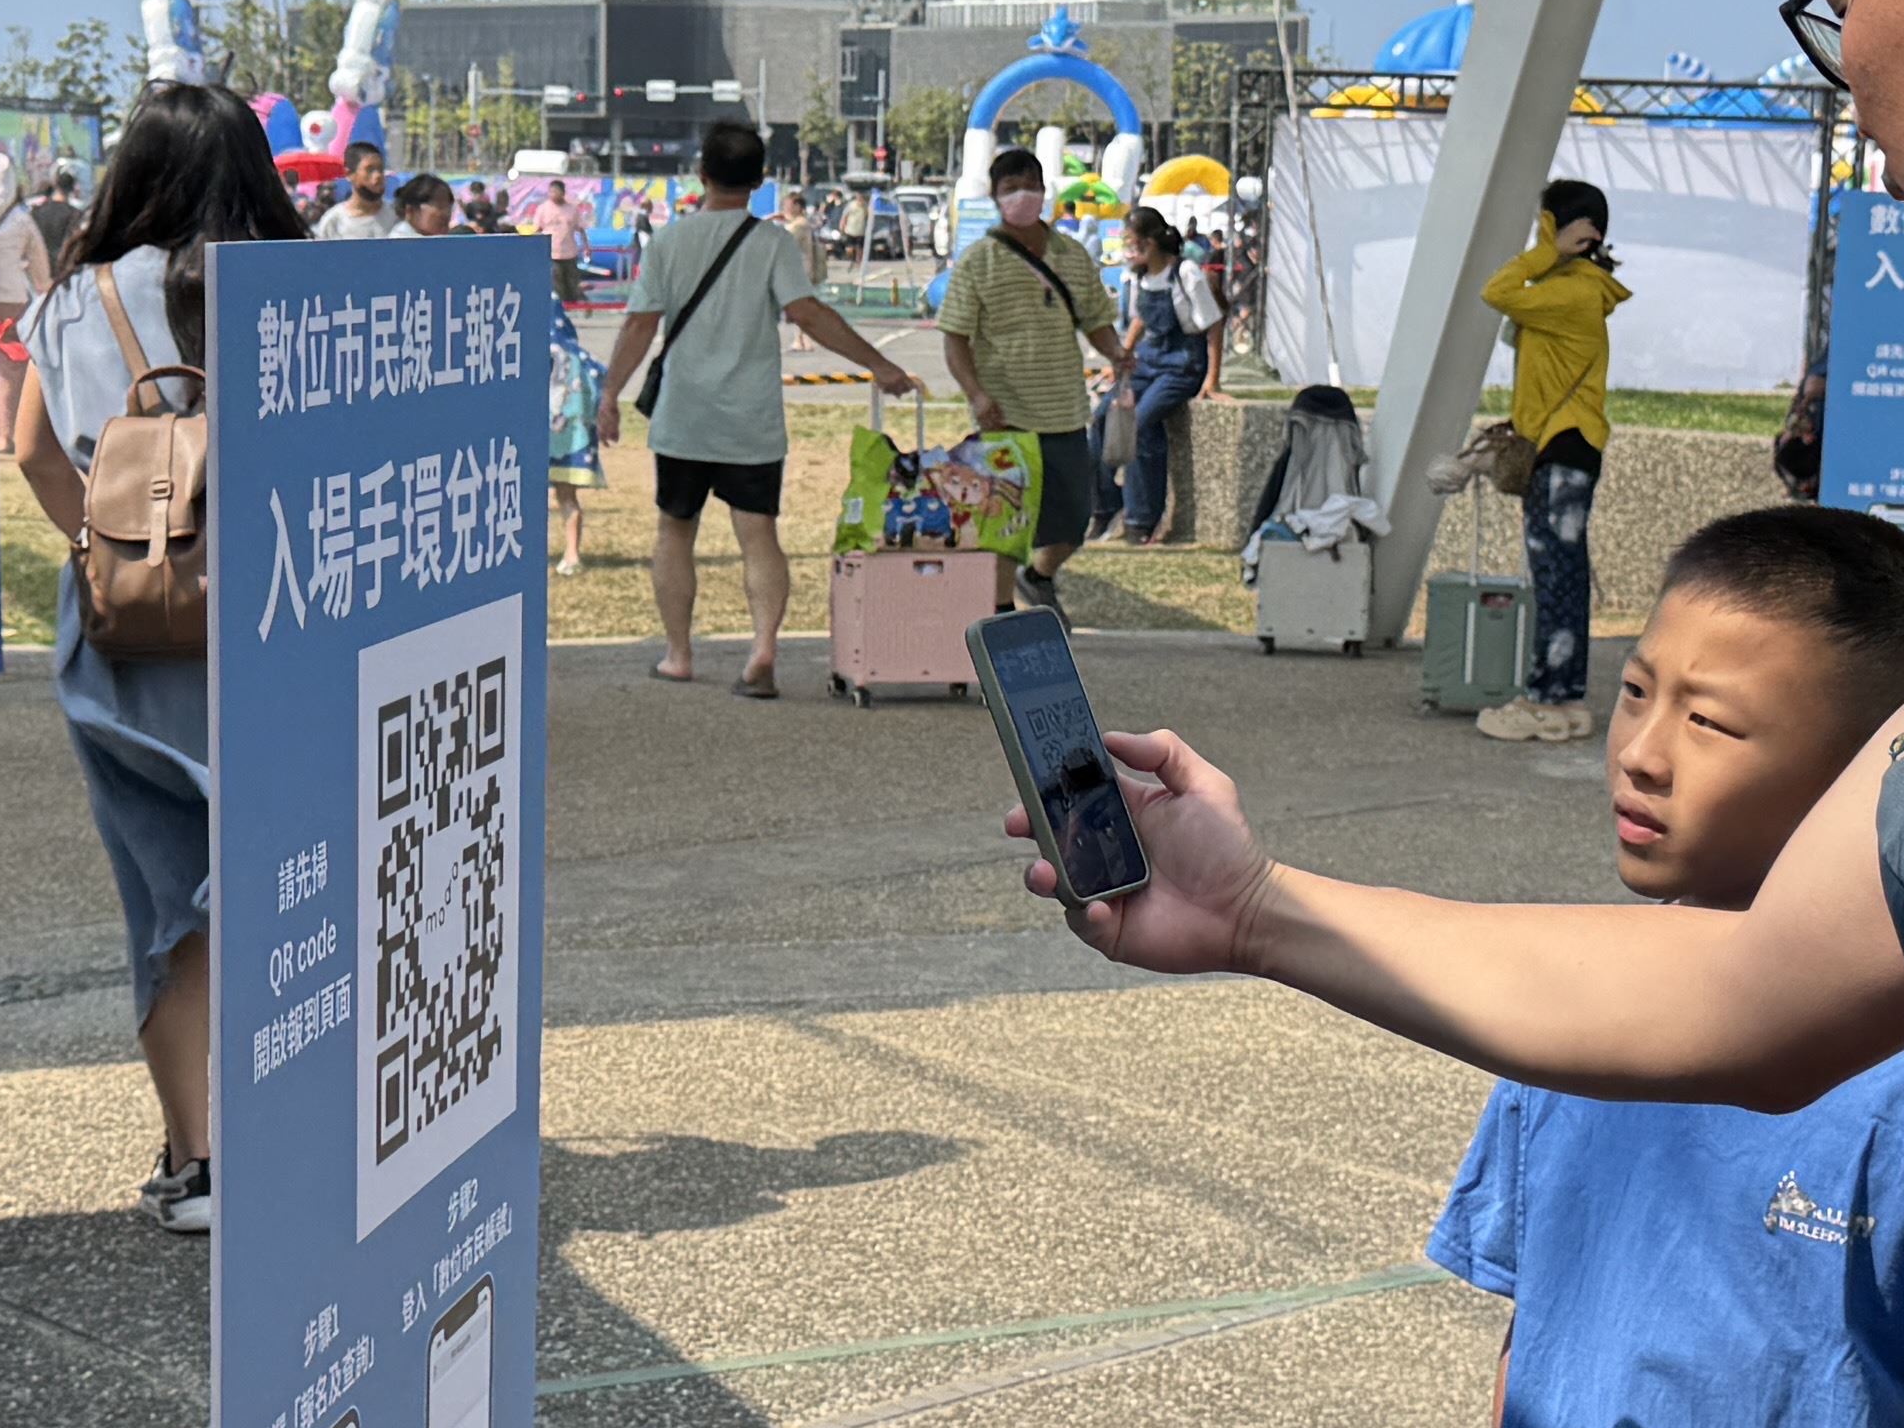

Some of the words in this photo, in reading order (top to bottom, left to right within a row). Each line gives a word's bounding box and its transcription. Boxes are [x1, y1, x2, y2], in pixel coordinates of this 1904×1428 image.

[257, 282, 523, 422] 數位市民線上報名
[257, 436, 524, 643] 入場手環兌換
[277, 840, 328, 915] 請先掃
[269, 940, 294, 997] QR
[297, 916, 337, 974] code
[253, 972, 353, 1085] 開啟報到頁面
[447, 1177, 479, 1233] 步驟2
[303, 1302, 340, 1368] 步驟1
